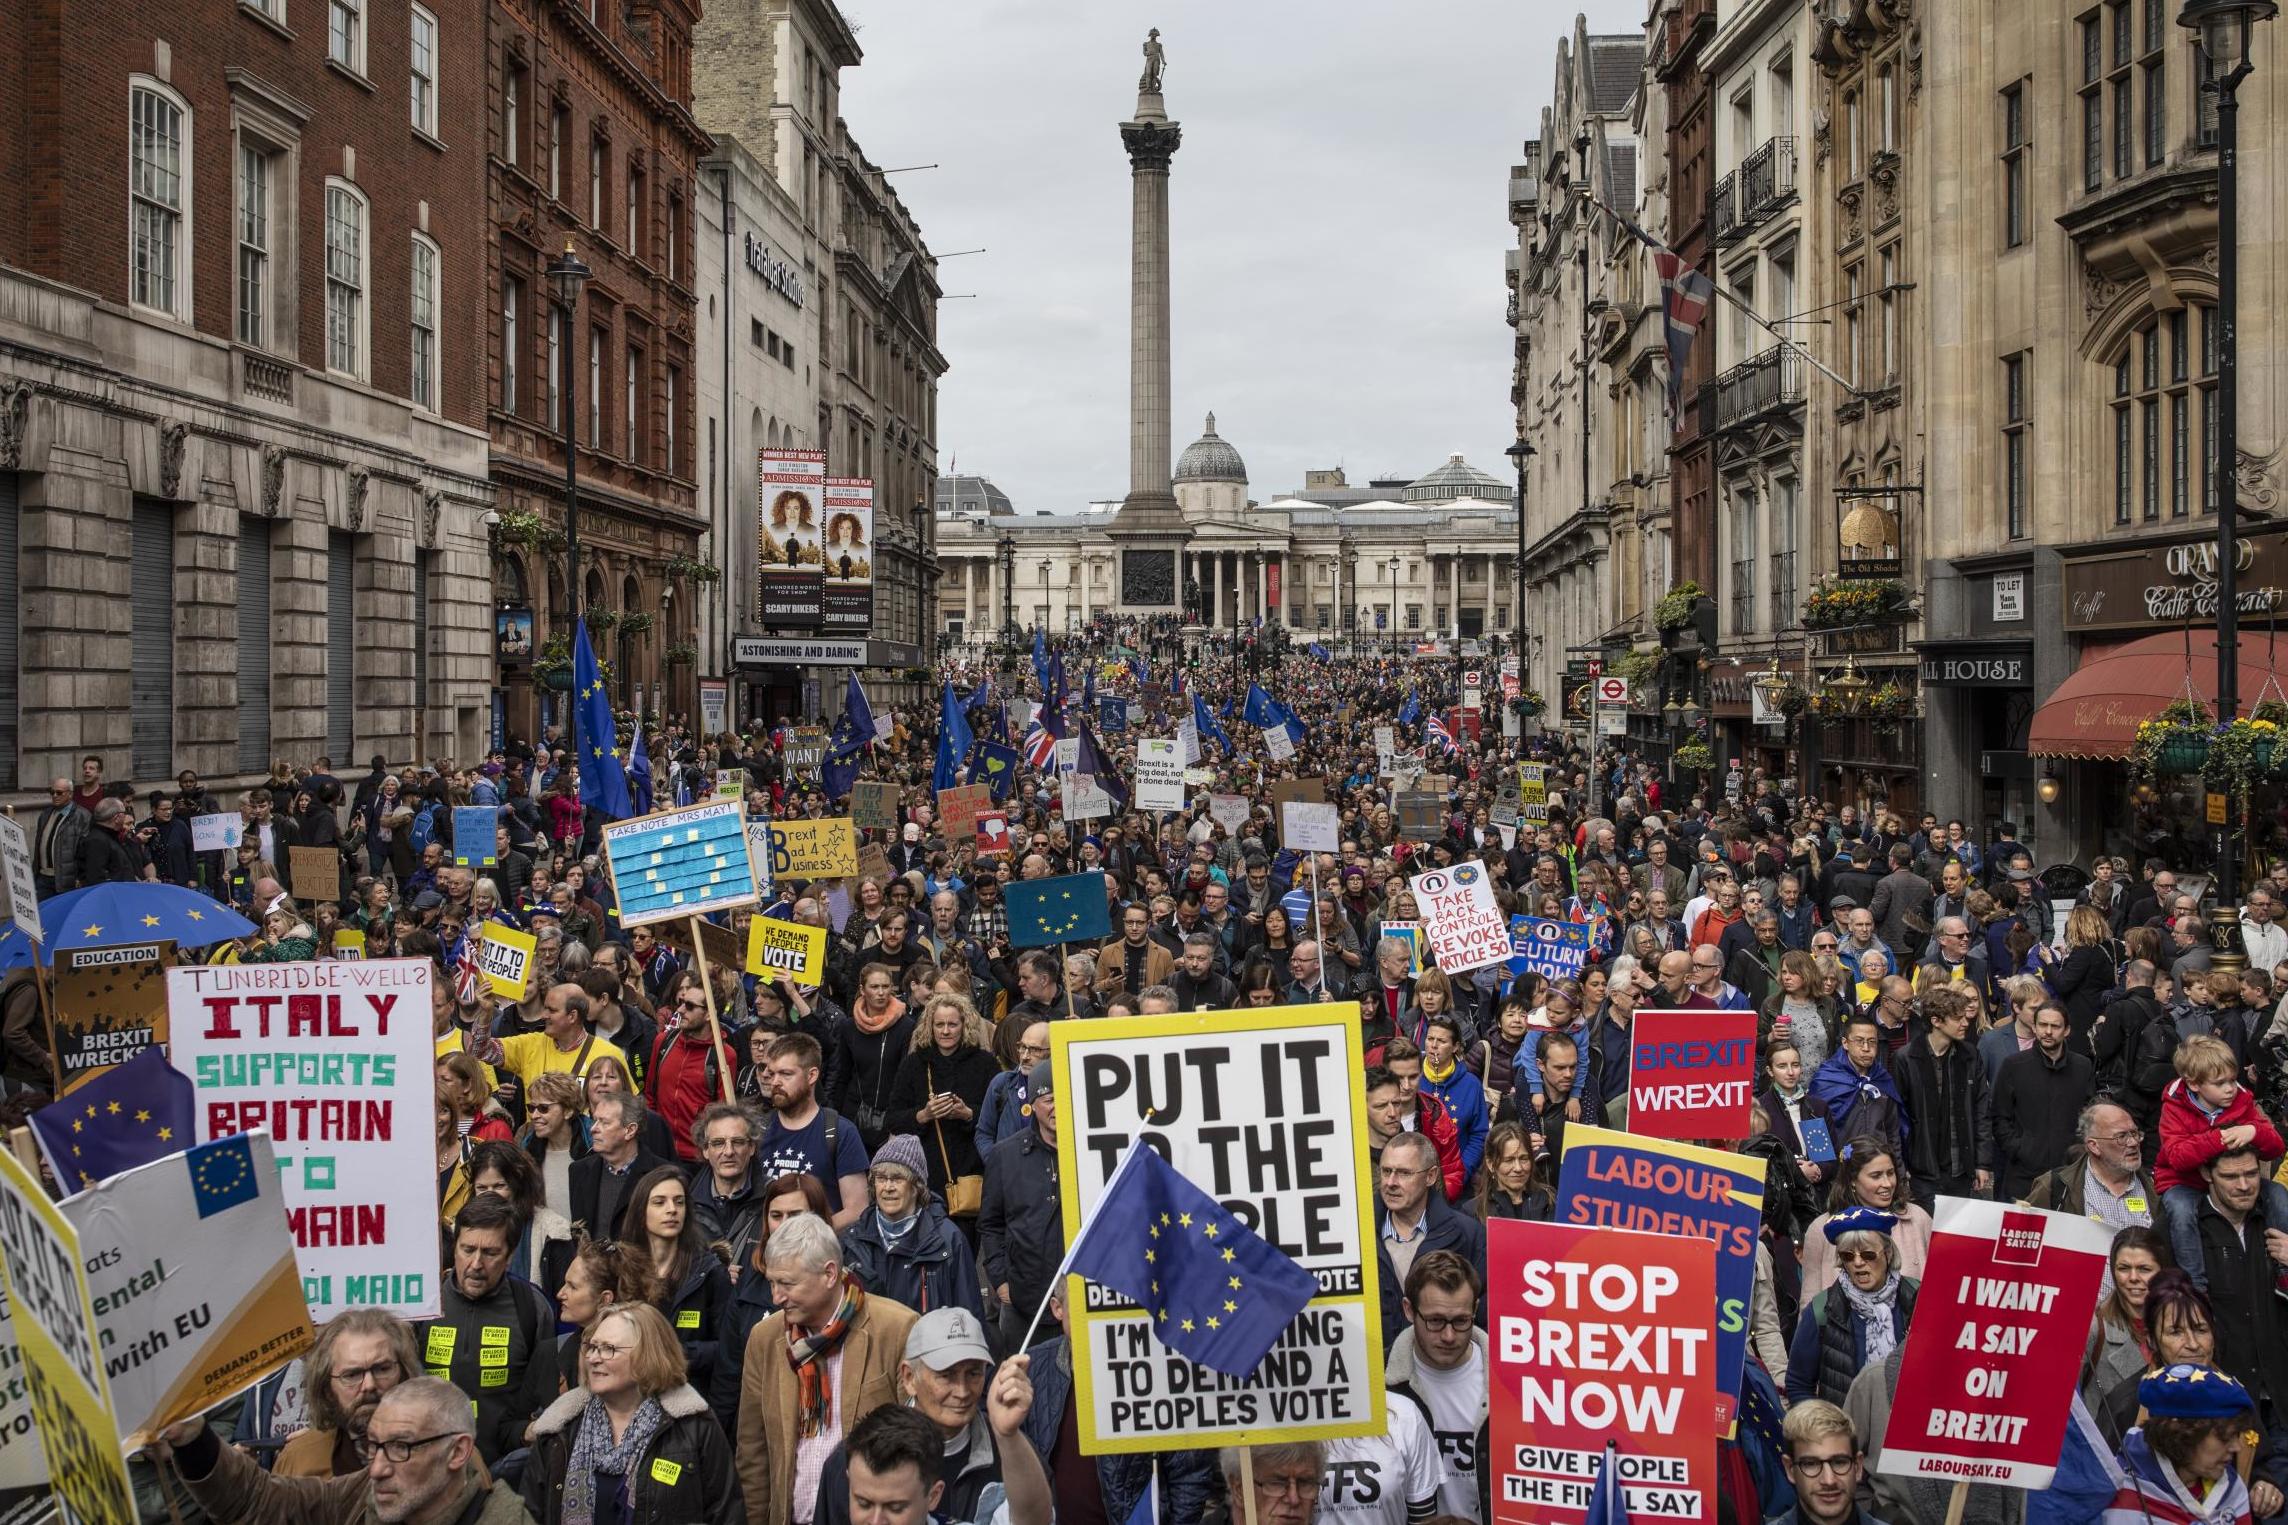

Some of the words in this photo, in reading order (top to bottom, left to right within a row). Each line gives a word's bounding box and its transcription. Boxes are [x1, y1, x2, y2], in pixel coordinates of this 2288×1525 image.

[765, 475, 821, 484] ADMISSIONS
[827, 499, 871, 507] DMISSIONS
[1842, 564, 1856, 573] The
[1858, 563, 1871, 573] Old
[1996, 581, 2005, 591] TO
[2007, 580, 2020, 591] LET
[765, 604, 792, 614] SCARY
[792, 604, 819, 614] BIKERS
[826, 613, 844, 622] CARY
[844, 614, 869, 623] BIKERS
[804, 646, 823, 657] AND
[1589, 663, 1600, 674] M
[1944, 659, 2021, 681] HOUSE
[785, 748, 821, 765] WANT
[1138, 759, 1160, 768] Brexit
[1161, 760, 1168, 768] is
[717, 772, 728, 781] UK
[785, 766, 793, 782] A
[1137, 766, 1150, 776] big
[1151, 767, 1170, 777] deal,
[1170, 769, 1184, 777] not
[1143, 777, 1163, 785] done
[1163, 778, 1183, 786] deal.
[609, 824, 637, 839] TAKE
[640, 817, 669, 832] NOTE
[677, 811, 700, 823] MRS
[702, 803, 732, 820] MAY!
[1524, 803, 1546, 819] VOTE
[810, 842, 820, 856] 4
[1430, 888, 1473, 912] TAKE
[1429, 907, 1499, 939] CONTROL?
[1436, 904, 1479, 924] BACK
[764, 935, 769, 945] A
[770, 936, 808, 952] PEOPLE'S
[765, 926, 776, 937] WE
[777, 928, 810, 944] DEMAND
[1431, 921, 1504, 956] REVOKE
[75, 948, 156, 966] EDUCATION
[496, 941, 508, 961] IT
[508, 948, 524, 968] TO
[763, 944, 806, 972] VOTE
[1439, 947, 1486, 972] ARTICLE
[1489, 941, 1509, 959] 50
[487, 959, 521, 982] PEOPLE
[1526, 961, 1572, 982] NOW
[202, 993, 399, 1040] ITALY
[82, 1027, 153, 1051] BREXIT
[1635, 1037, 1752, 1071] BREXIT
[195, 1052, 397, 1089] SUPPORTS
[1083, 1046, 1231, 1129] PUT
[1260, 1040, 1331, 1119] IT
[1633, 1080, 1751, 1114] WREXIT
[207, 1099, 393, 1143] BRITAIN
[774, 1159, 800, 1169] PROUD
[1197, 1119, 1339, 1196] THE
[1586, 1149, 1733, 1207] LABOUR
[1568, 1193, 1753, 1258] STUDENTS
[2001, 1228, 2041, 1242] LABOUR
[2005, 1237, 2040, 1251] SAY.EU
[345, 1273, 423, 1305] MAIO
[1521, 1258, 1680, 1315] STOP
[1957, 1275, 1970, 1305] I
[1975, 1278, 2060, 1315] WANT
[104, 1328, 170, 1381] with
[174, 1302, 212, 1340] EU
[1105, 1322, 1150, 1360] I'M
[1500, 1316, 1708, 1377] BREXIT
[1955, 1322, 1977, 1351] A
[1981, 1323, 2039, 1357] SAY
[204, 1346, 259, 1386] DEMAND
[260, 1325, 306, 1356] BETTER
[1107, 1360, 1152, 1398] TO
[1327, 1347, 1349, 1384] A
[1965, 1367, 2009, 1399] ON
[1110, 1394, 1258, 1434] PEOPLES
[1270, 1387, 1352, 1423] VOTE
[1520, 1376, 1685, 1435] NOW
[1925, 1408, 2029, 1446] BREXIT
[1518, 1447, 1579, 1474] GIVE
[1588, 1455, 1685, 1483] POPLE
[1918, 1457, 2013, 1480] LABOURSAY.EU
[1506, 1477, 1553, 1503] THE
[1646, 1491, 1699, 1516] SAY
